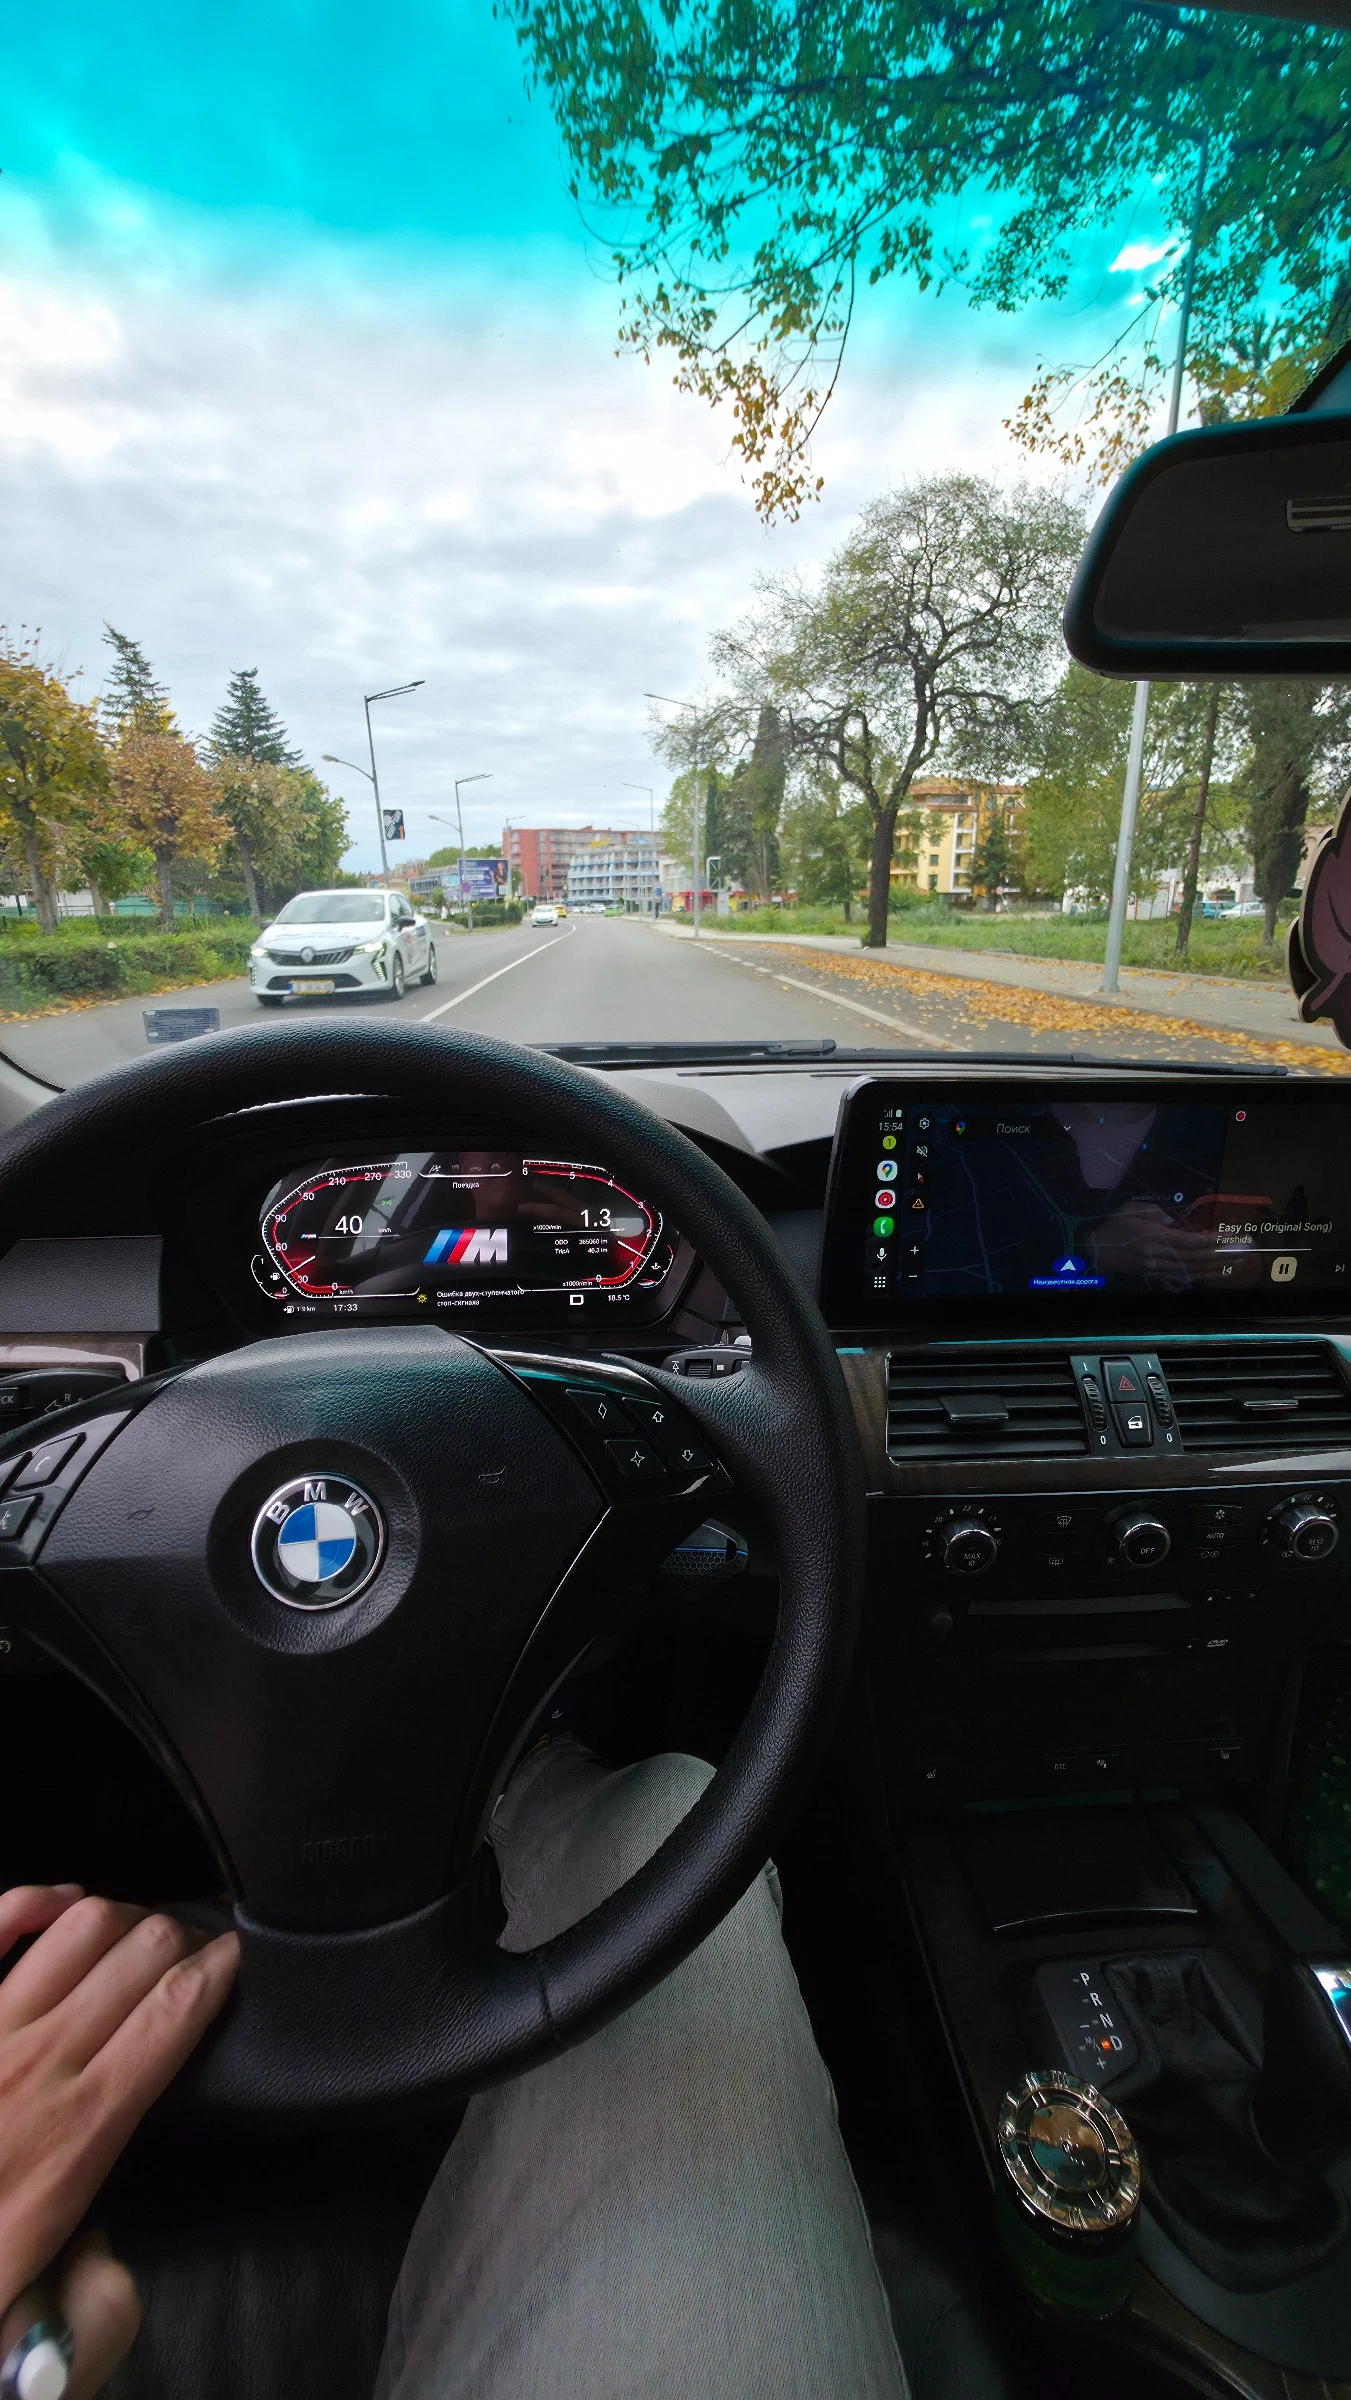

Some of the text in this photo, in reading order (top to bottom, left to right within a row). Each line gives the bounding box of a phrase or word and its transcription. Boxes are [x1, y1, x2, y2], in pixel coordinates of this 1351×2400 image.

[878, 1122, 903, 1131] 15:54
[996, 1123, 1031, 1134] Поиск
[394, 1171, 412, 1179] 330
[522, 1167, 528, 1176] 6
[569, 1172, 576, 1180] 5
[364, 1172, 382, 1181] 270
[328, 1177, 346, 1186] 210
[452, 1182, 480, 1190] Поездка
[607, 1180, 614, 1188] 4
[637, 1201, 644, 1209] 3
[274, 1214, 287, 1223] 90
[580, 1208, 611, 1228] 1.3
[335, 1215, 363, 1235] 40
[1218, 1222, 1333, 1234] Easy Go (Original Song)
[646, 1229, 652, 1237] 2
[1216, 1235, 1252, 1244] Farshids
[275, 1242, 288, 1251] 60
[629, 1261, 635, 1269] 1
[297, 1275, 309, 1284] 30
[595, 1274, 602, 1283] 0
[331, 1282, 338, 1291] 0
[436, 1290, 463, 1298] Ошибка
[333, 1304, 358, 1312] 17:33
[64, 1393, 71, 1402] R
[265, 1481, 370, 1526] BMW
[1308, 1538, 1324, 1546] REST
[1140, 1547, 1156, 1555] OFF
[963, 1552, 981, 1560] MAX
[1080, 1972, 1090, 1987] P
[1089, 1992, 1103, 2007] R
[1099, 2012, 1114, 2028] N
[1109, 2035, 1123, 2051] D
